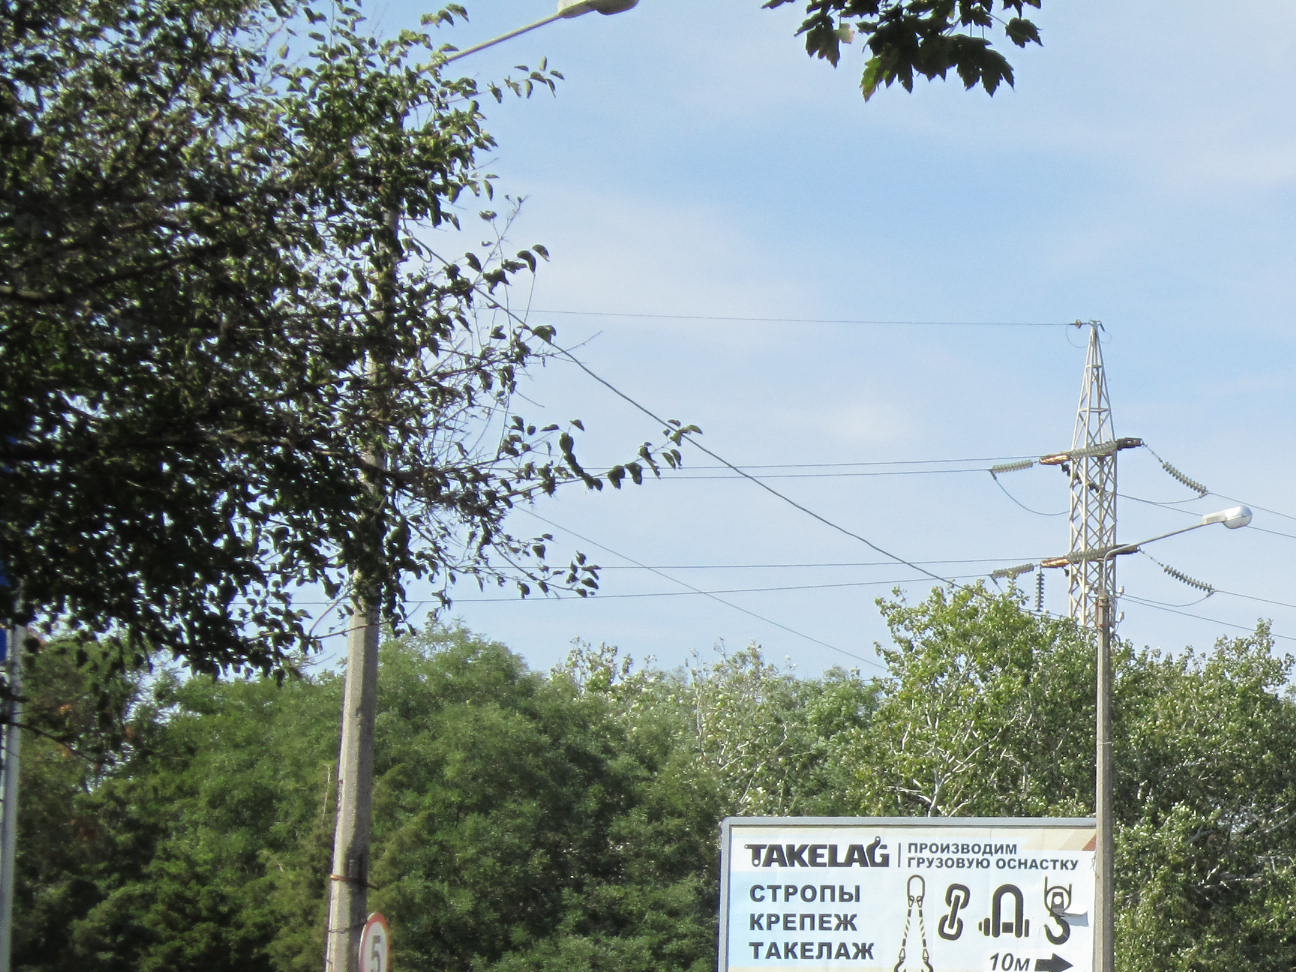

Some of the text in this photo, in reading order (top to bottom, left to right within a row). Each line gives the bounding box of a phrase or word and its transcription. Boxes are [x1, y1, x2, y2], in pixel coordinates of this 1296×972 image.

[744, 836, 890, 868] TAKELAG
[908, 842, 1018, 856] ПРОИЗВОДИМ
[907, 857, 1080, 871] ГРУЗОВУЮ ОСНАСТКУ
[749, 884, 860, 903] СТРОПЫ
[749, 913, 858, 932] КРЕПЕЖ
[749, 941, 875, 960] ТАКЕЛАЖ
